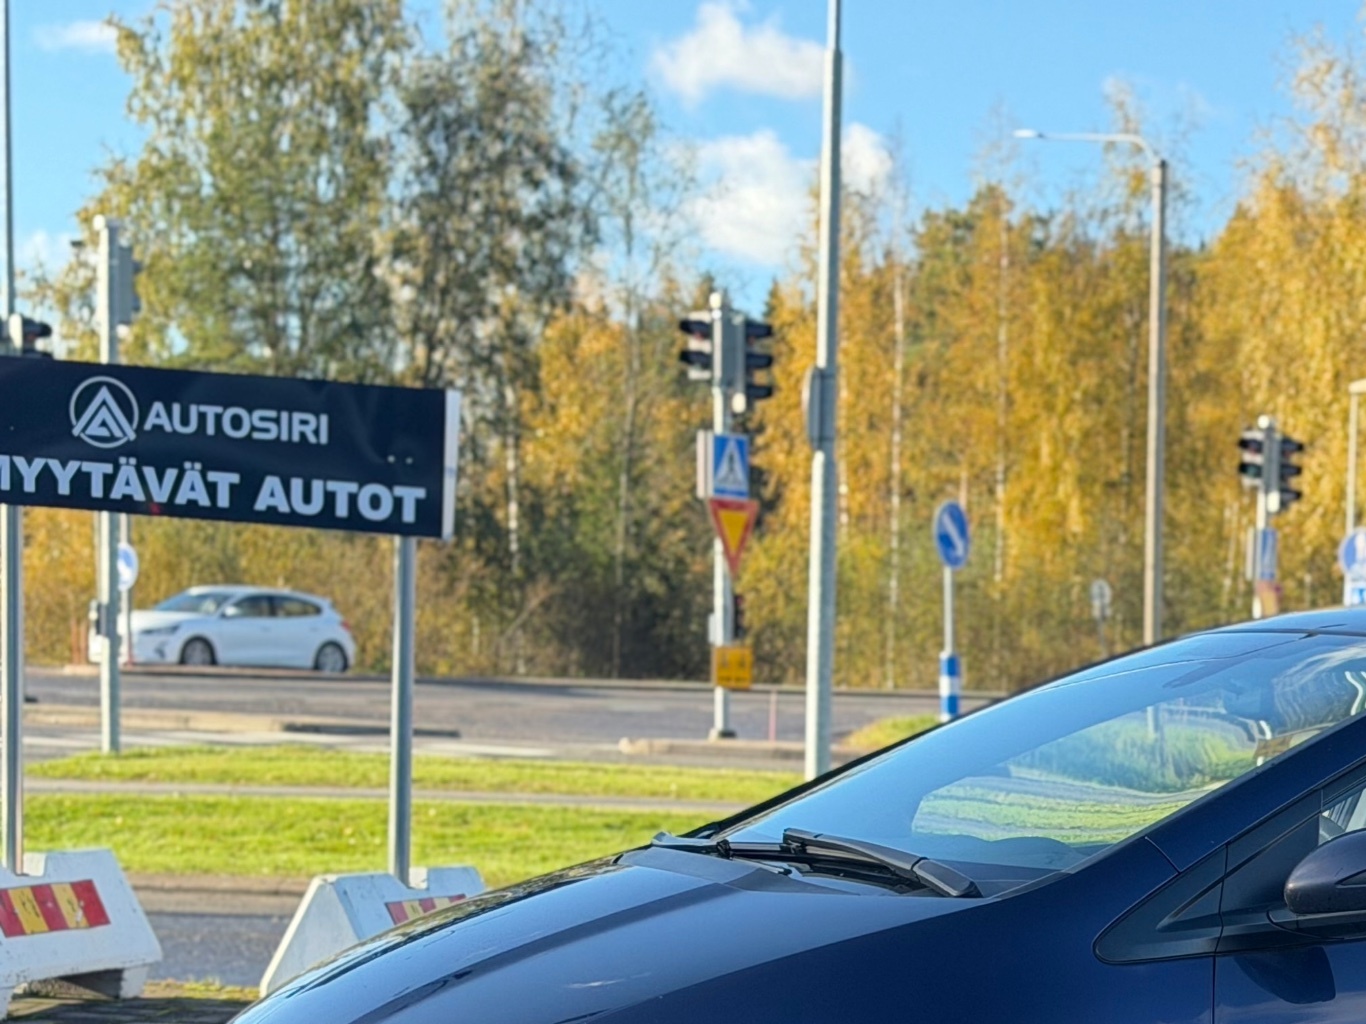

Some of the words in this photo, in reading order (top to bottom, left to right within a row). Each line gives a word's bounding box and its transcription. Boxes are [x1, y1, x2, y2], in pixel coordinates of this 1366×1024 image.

[143, 401, 329, 445] AUTOSIRI
[0, 454, 241, 508] YYTÄVÄT
[253, 475, 426, 524] AUTOT
